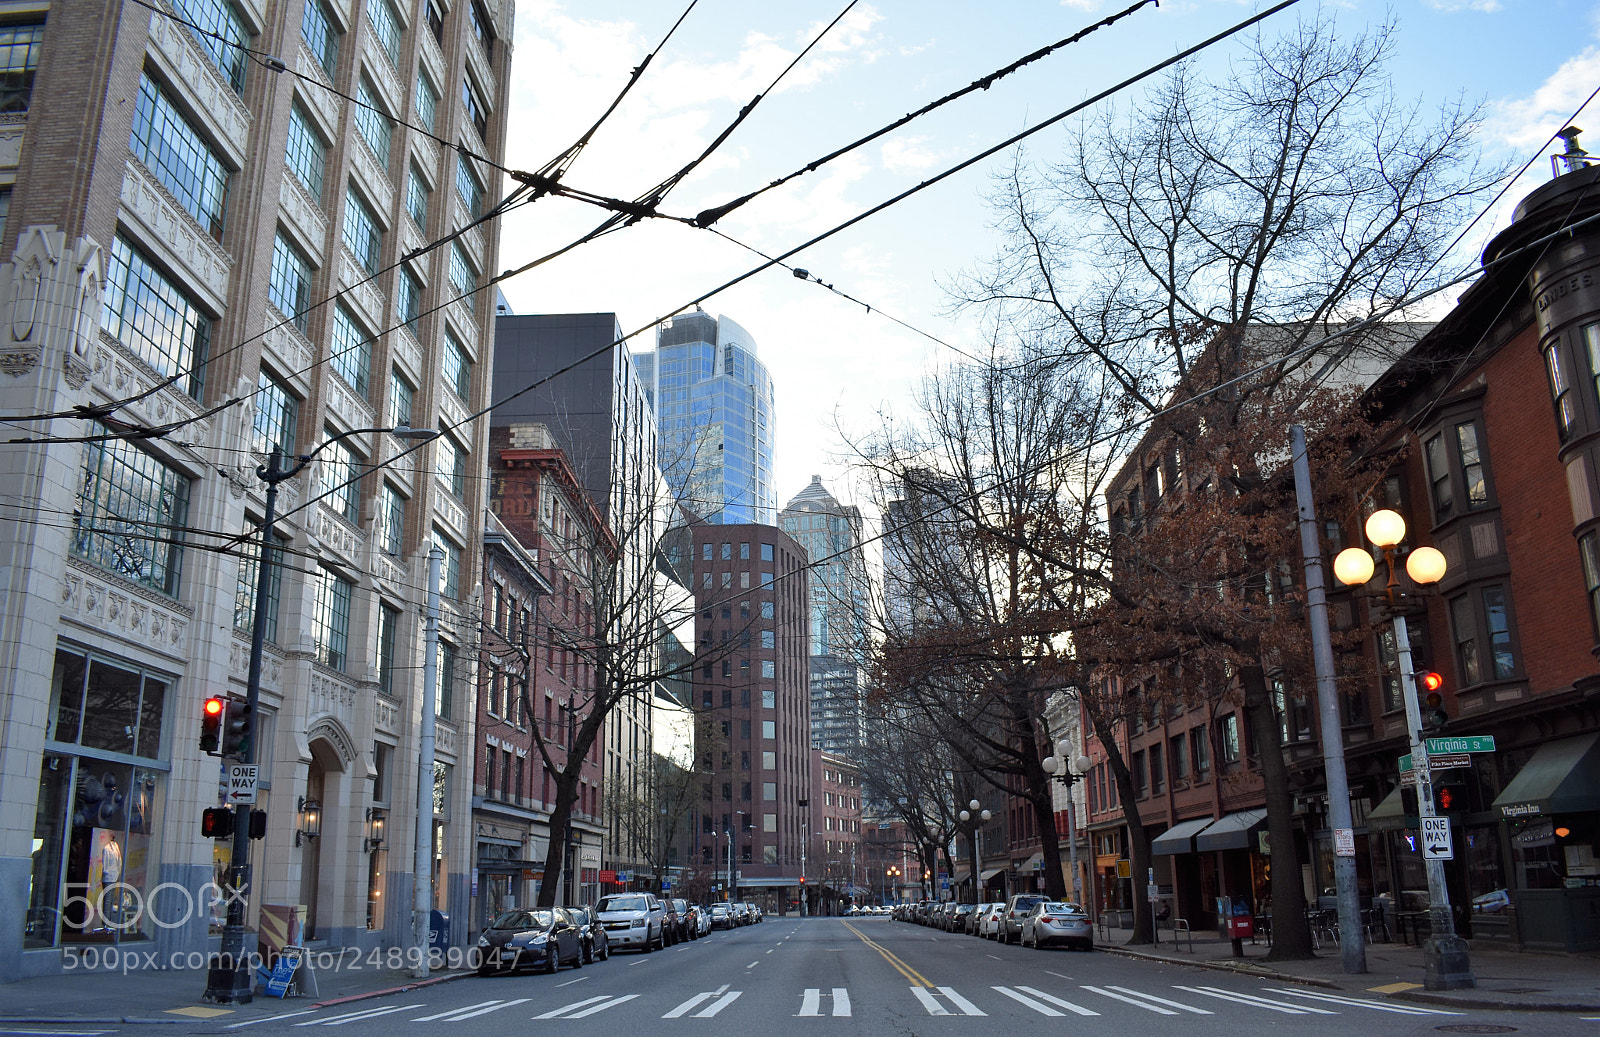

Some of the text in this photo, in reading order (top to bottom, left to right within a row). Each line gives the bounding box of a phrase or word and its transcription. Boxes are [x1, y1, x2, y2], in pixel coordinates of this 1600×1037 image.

[1538, 274, 1593, 312] LANDES
[1430, 738, 1481, 752] Virginia St
[232, 767, 256, 777] ONE
[231, 778, 256, 788] WAY
[1501, 803, 1540, 817] Virginia Inn
[1425, 820, 1447, 831] ONE
[1425, 832, 1448, 842] WAY
